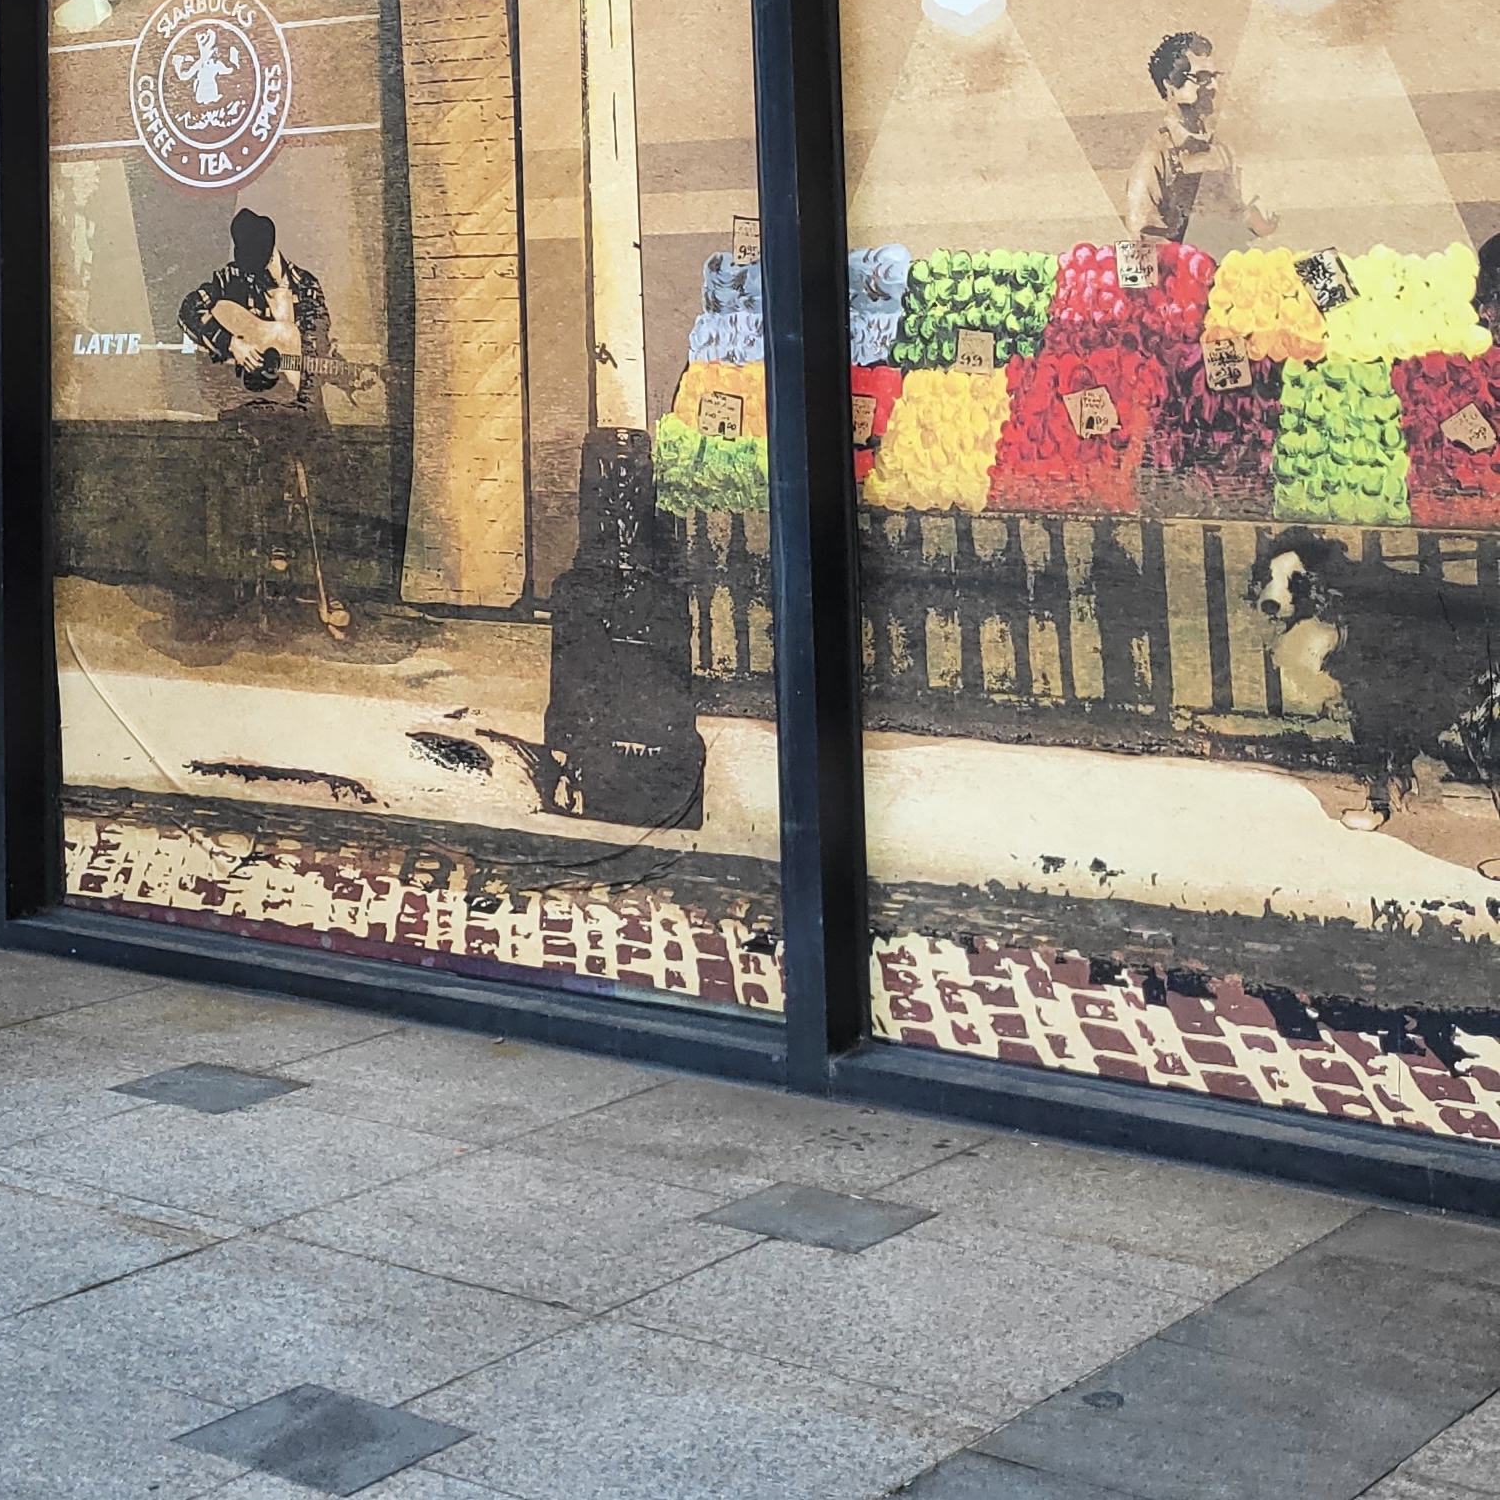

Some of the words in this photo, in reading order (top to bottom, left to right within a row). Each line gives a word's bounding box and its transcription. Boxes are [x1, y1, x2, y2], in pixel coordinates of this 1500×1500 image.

[137, 75, 176, 158] COFFEE
[198, 152, 233, 176] TEA
[251, 64, 282, 142] SPICES
[73, 333, 141, 355] LATTE
